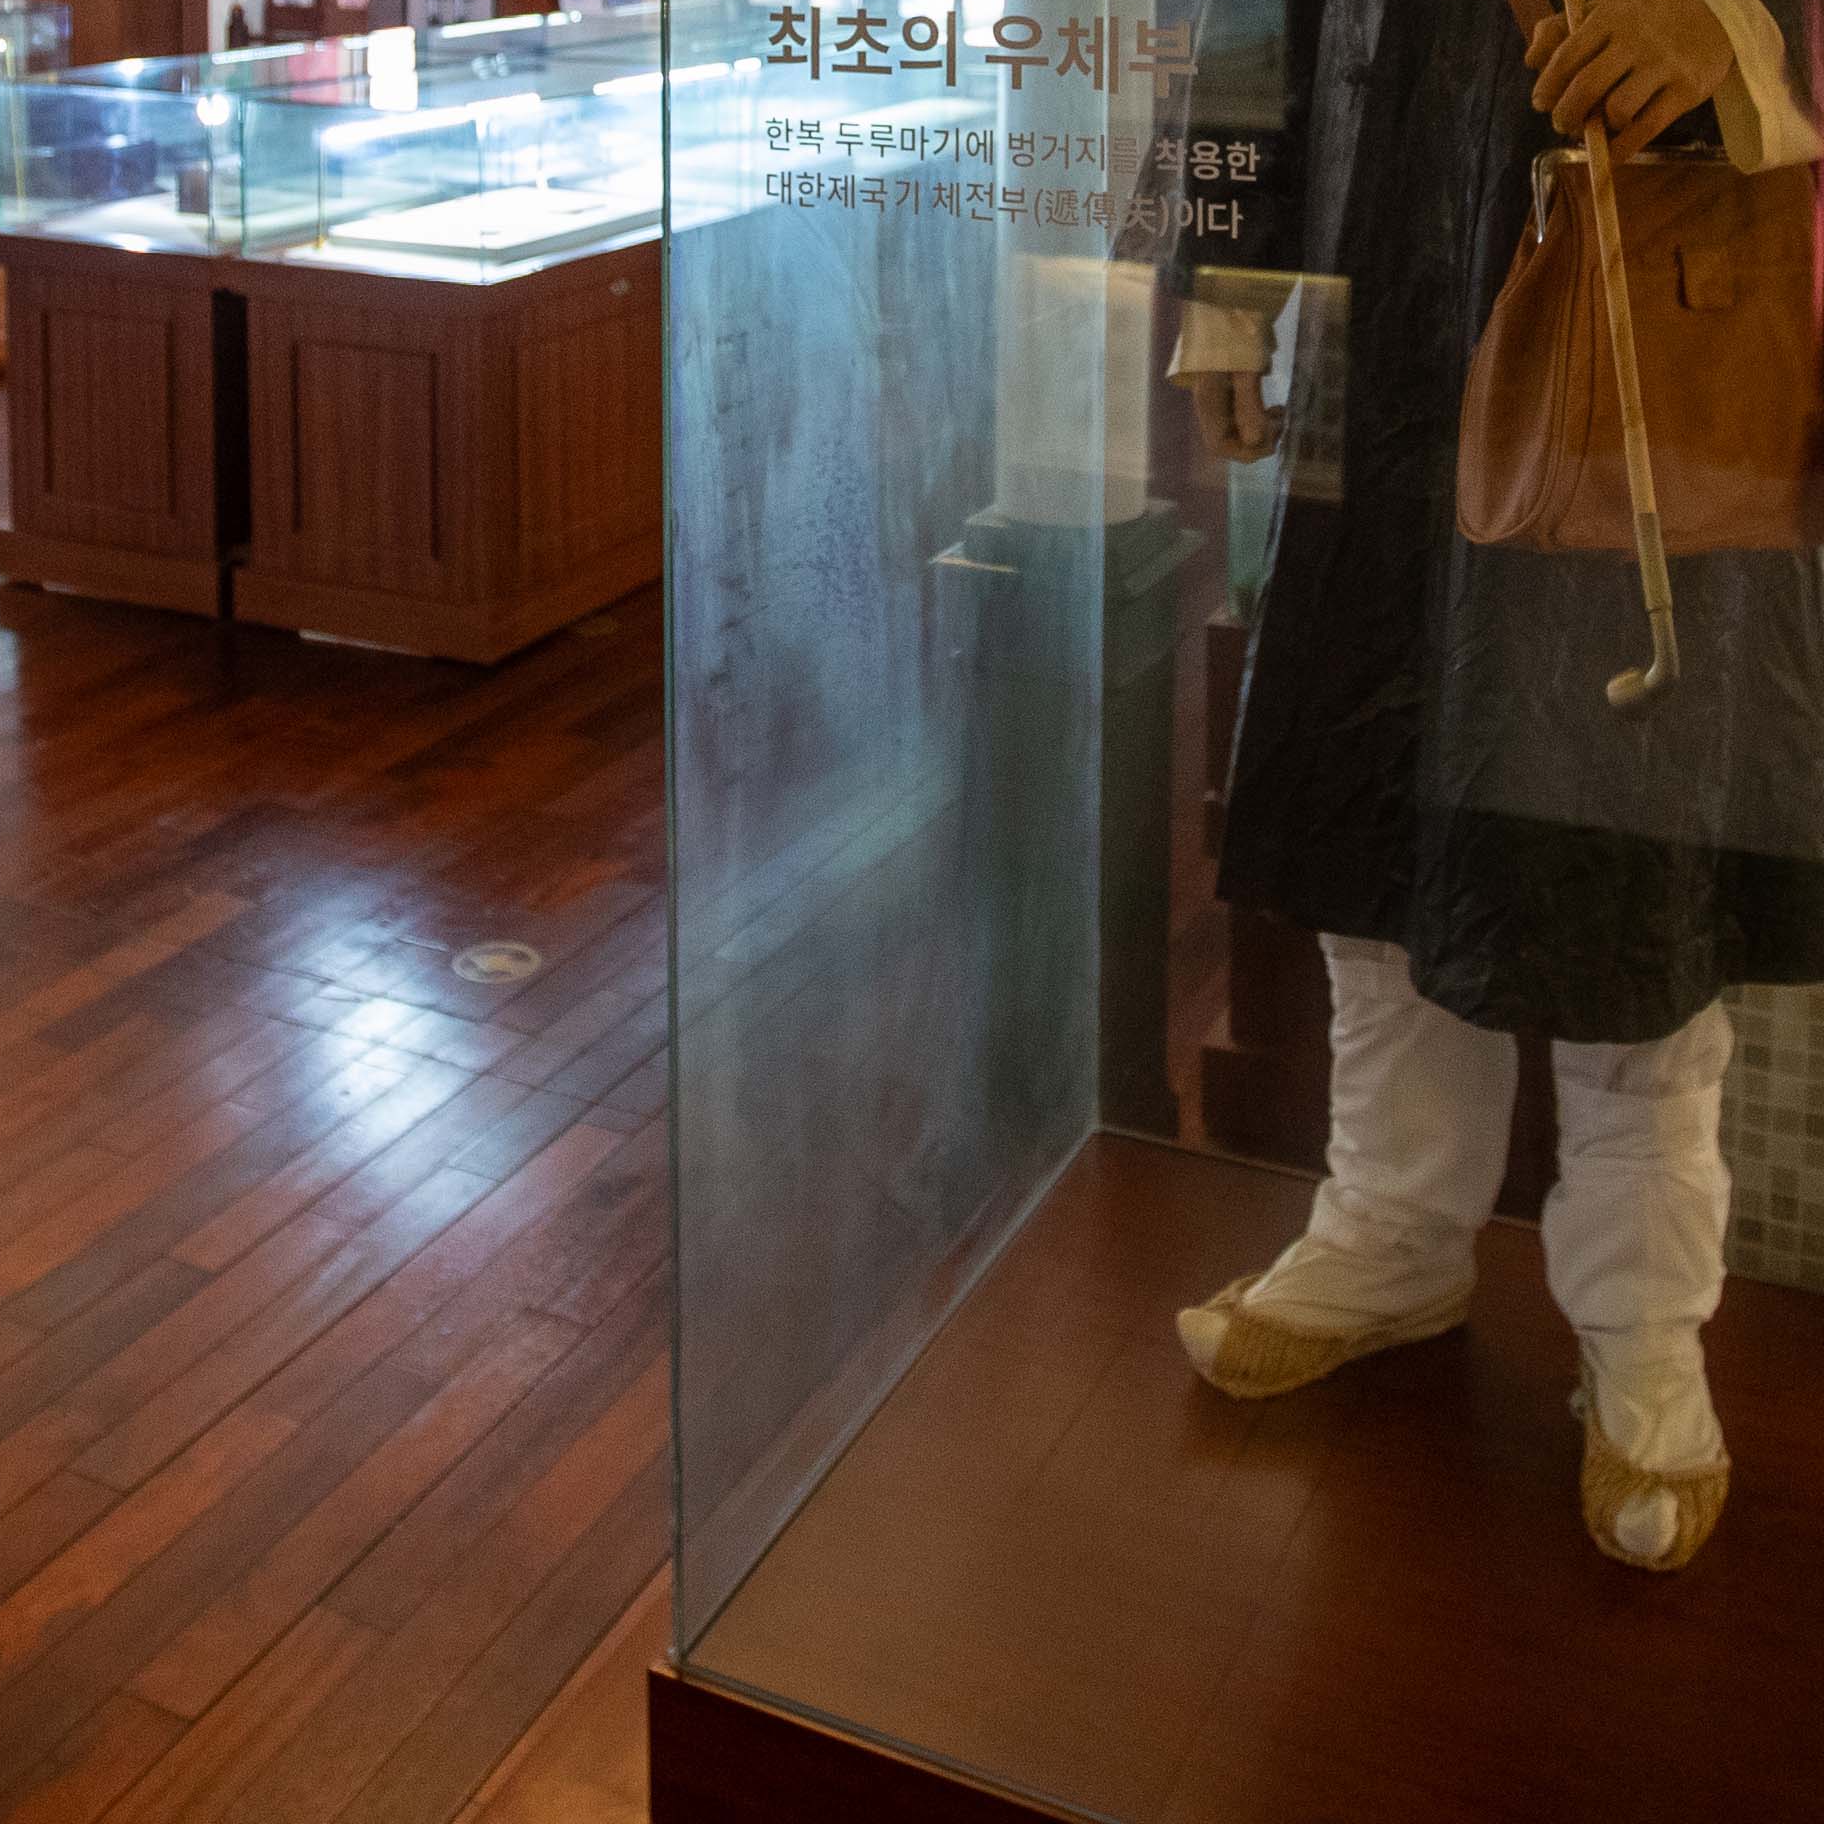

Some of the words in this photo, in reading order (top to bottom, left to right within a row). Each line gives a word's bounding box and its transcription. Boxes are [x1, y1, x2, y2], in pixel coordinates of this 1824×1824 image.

[766, 5, 956, 87] 최초의
[984, 15, 1198, 98] 우체부
[764, 116, 824, 155] 한복
[835, 121, 995, 166] 두루마기에
[1007, 130, 1138, 178] 벙거지를
[1154, 137, 1261, 182] 착용한
[765, 170, 920, 216] 대한제국기
